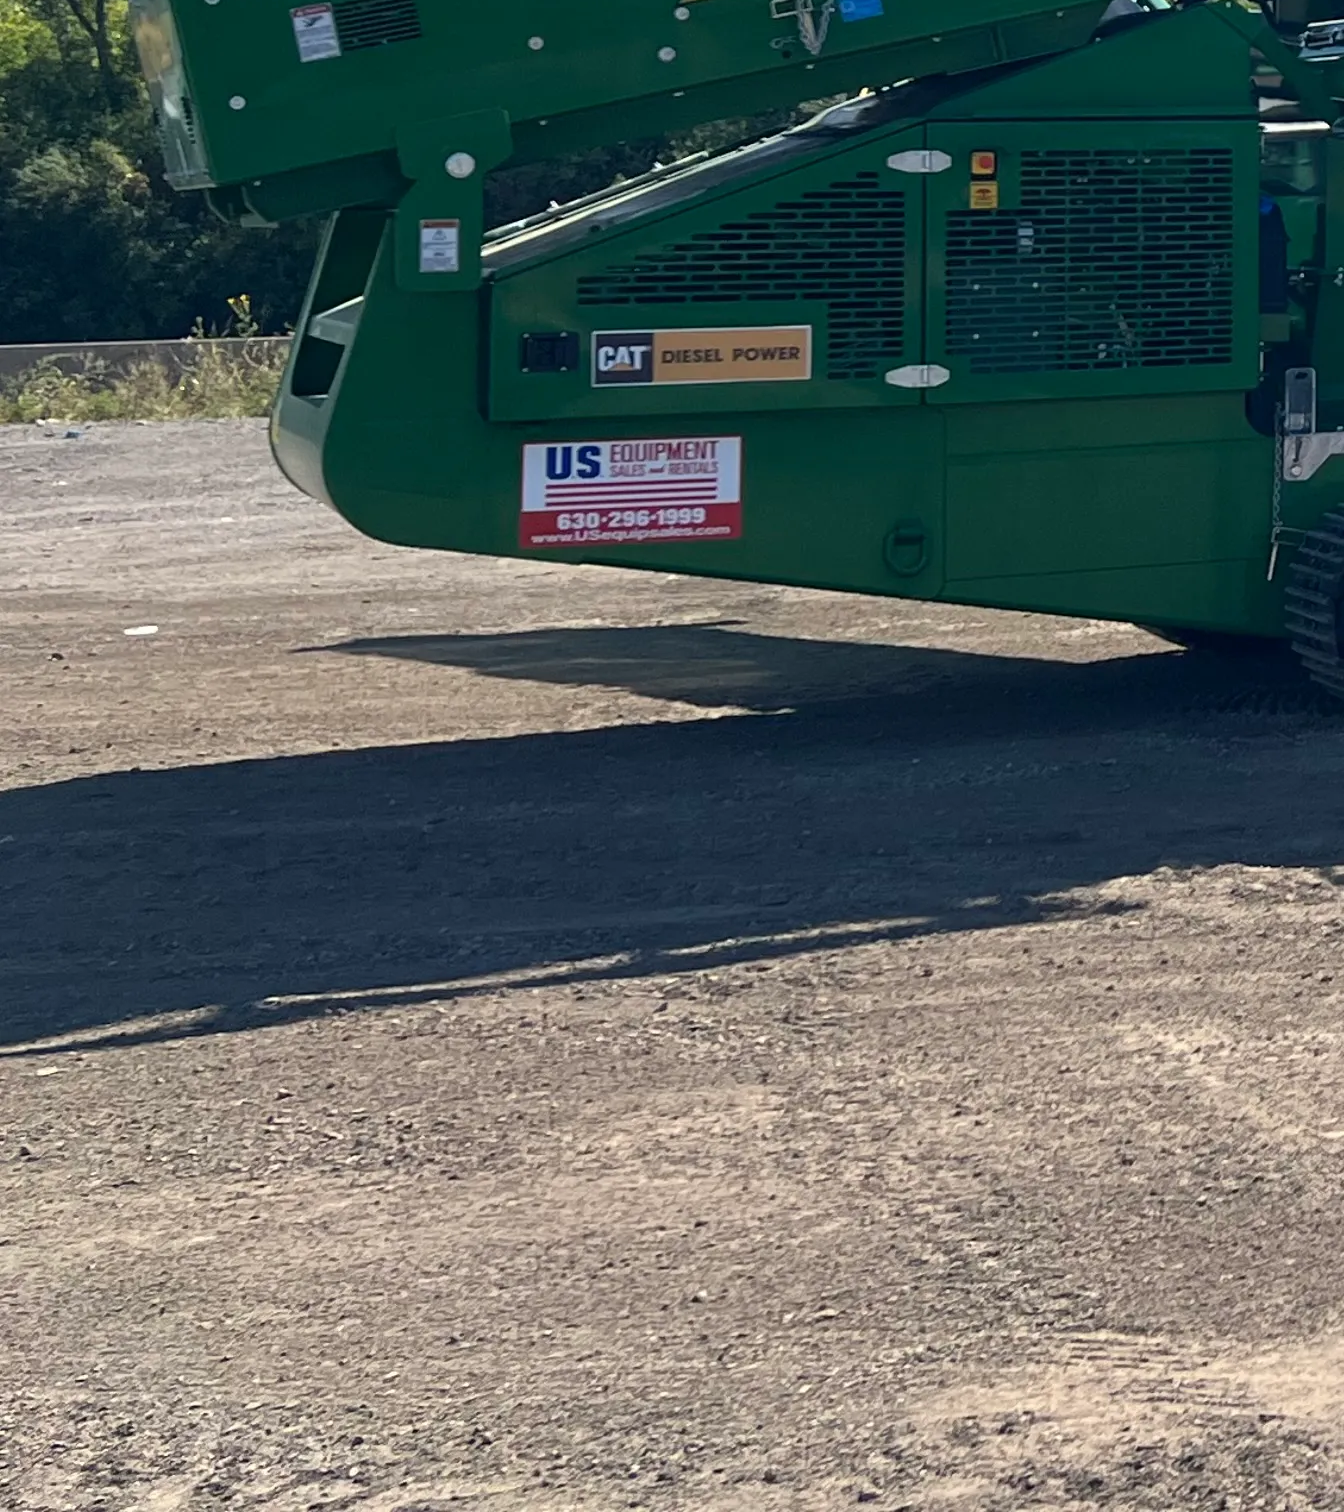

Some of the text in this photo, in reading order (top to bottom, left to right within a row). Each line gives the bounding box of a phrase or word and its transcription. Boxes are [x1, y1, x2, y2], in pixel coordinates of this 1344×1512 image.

[598, 346, 800, 371] CAT DIESEL POWER
[610, 440, 719, 463] EQUIPMENT
[609, 464, 646, 478] SALES
[667, 461, 719, 476] RENTALS
[531, 525, 731, 544] www.USequipsales.com
